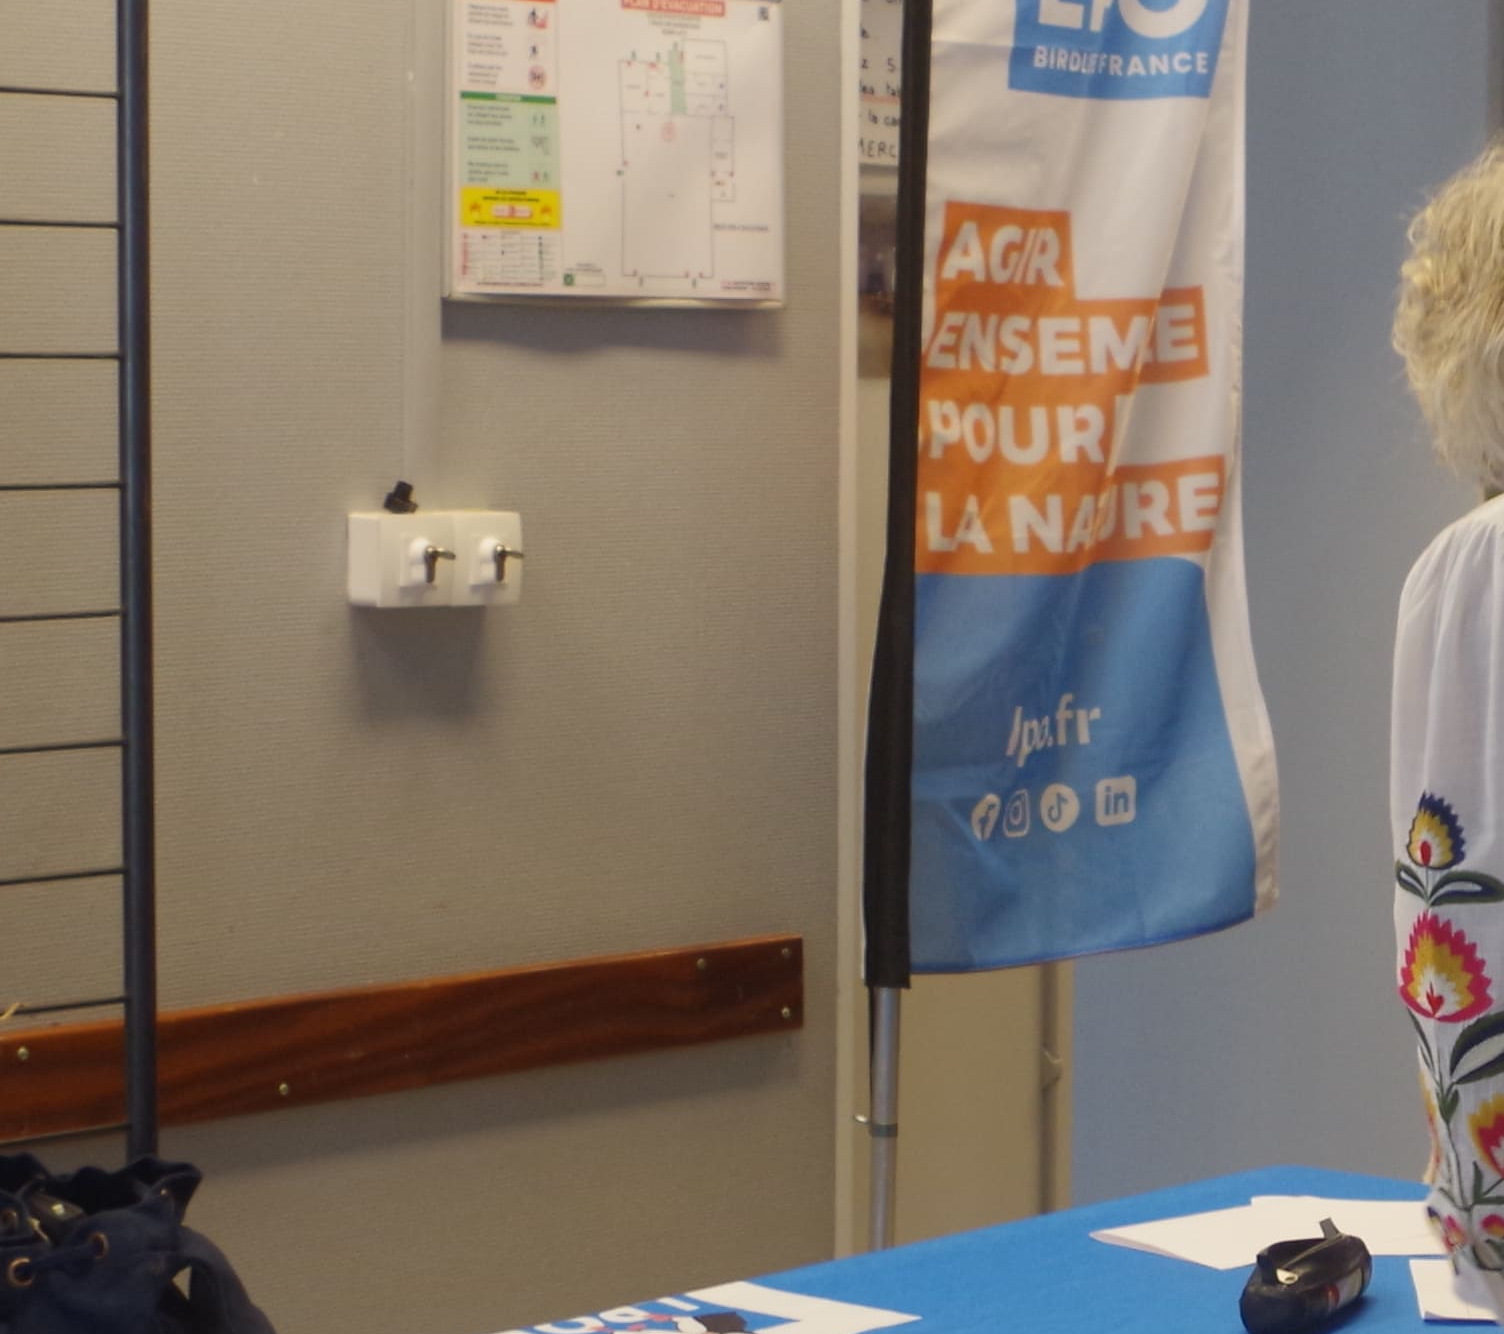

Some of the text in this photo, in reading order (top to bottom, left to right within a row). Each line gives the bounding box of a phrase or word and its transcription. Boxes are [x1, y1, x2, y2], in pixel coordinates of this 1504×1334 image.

[941, 220, 1065, 287] AGIR
[926, 398, 1106, 465] POUR
[925, 491, 994, 554] LA
